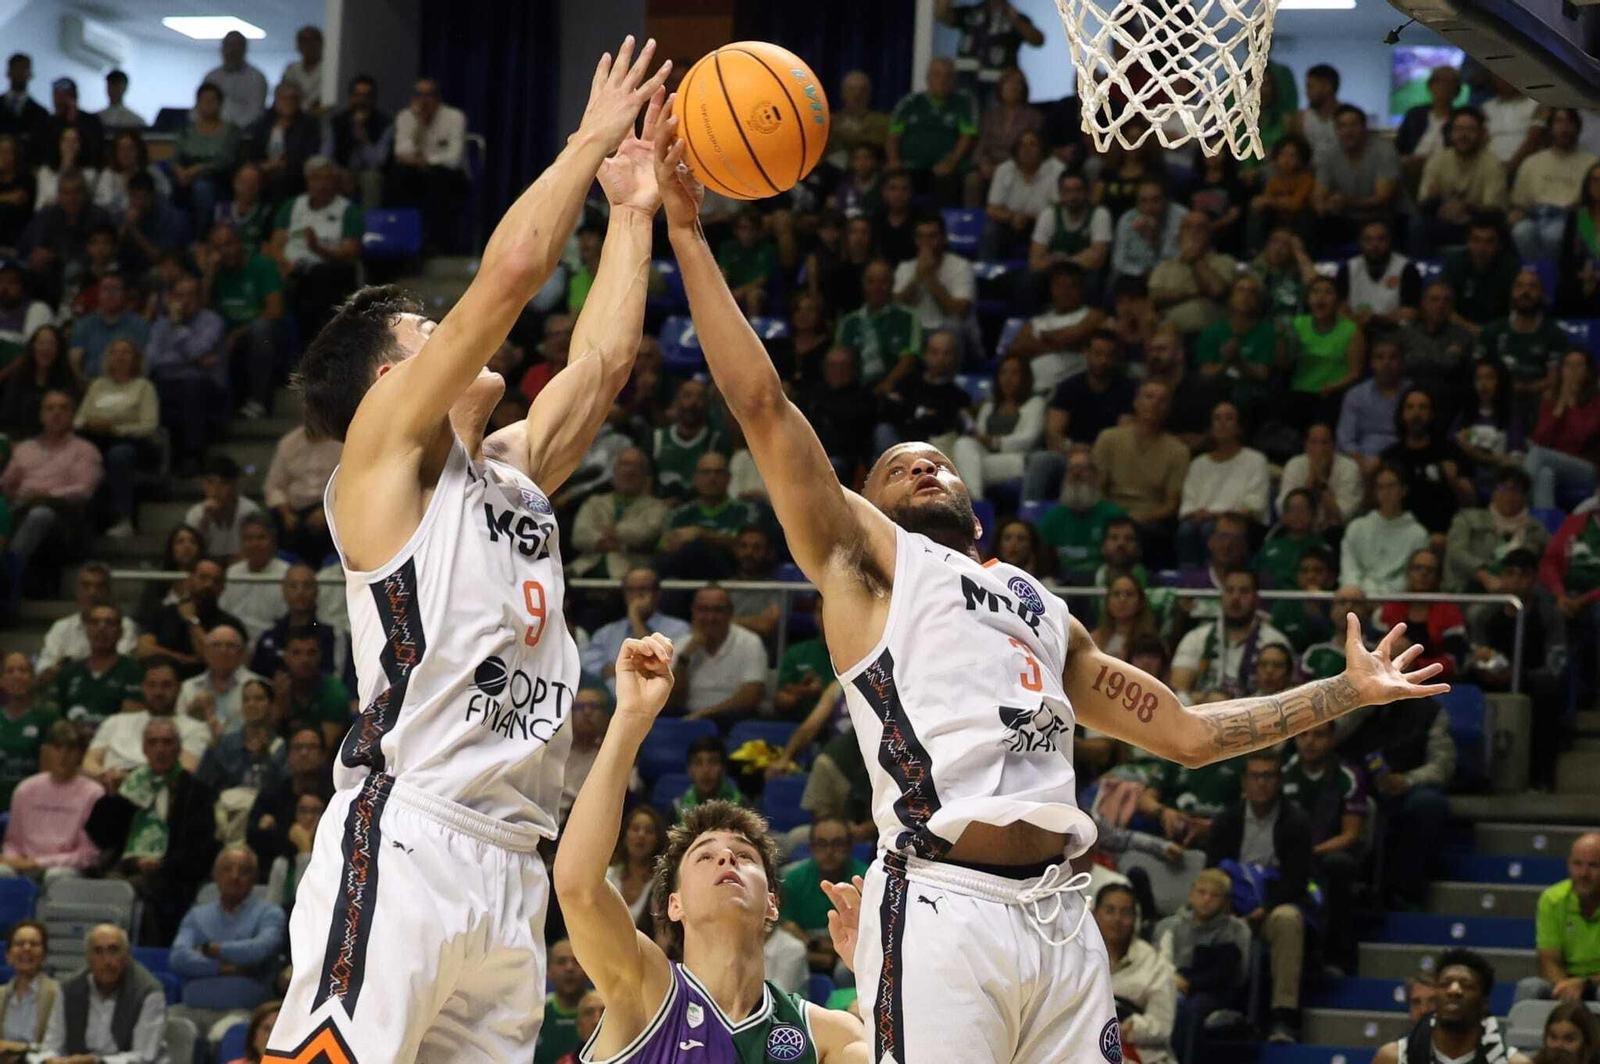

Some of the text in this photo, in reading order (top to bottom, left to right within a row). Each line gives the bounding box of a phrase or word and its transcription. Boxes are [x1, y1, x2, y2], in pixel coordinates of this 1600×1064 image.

[523, 580, 547, 647] 9
[1008, 637, 1044, 692] 3
[1091, 665, 1159, 723] 1998
